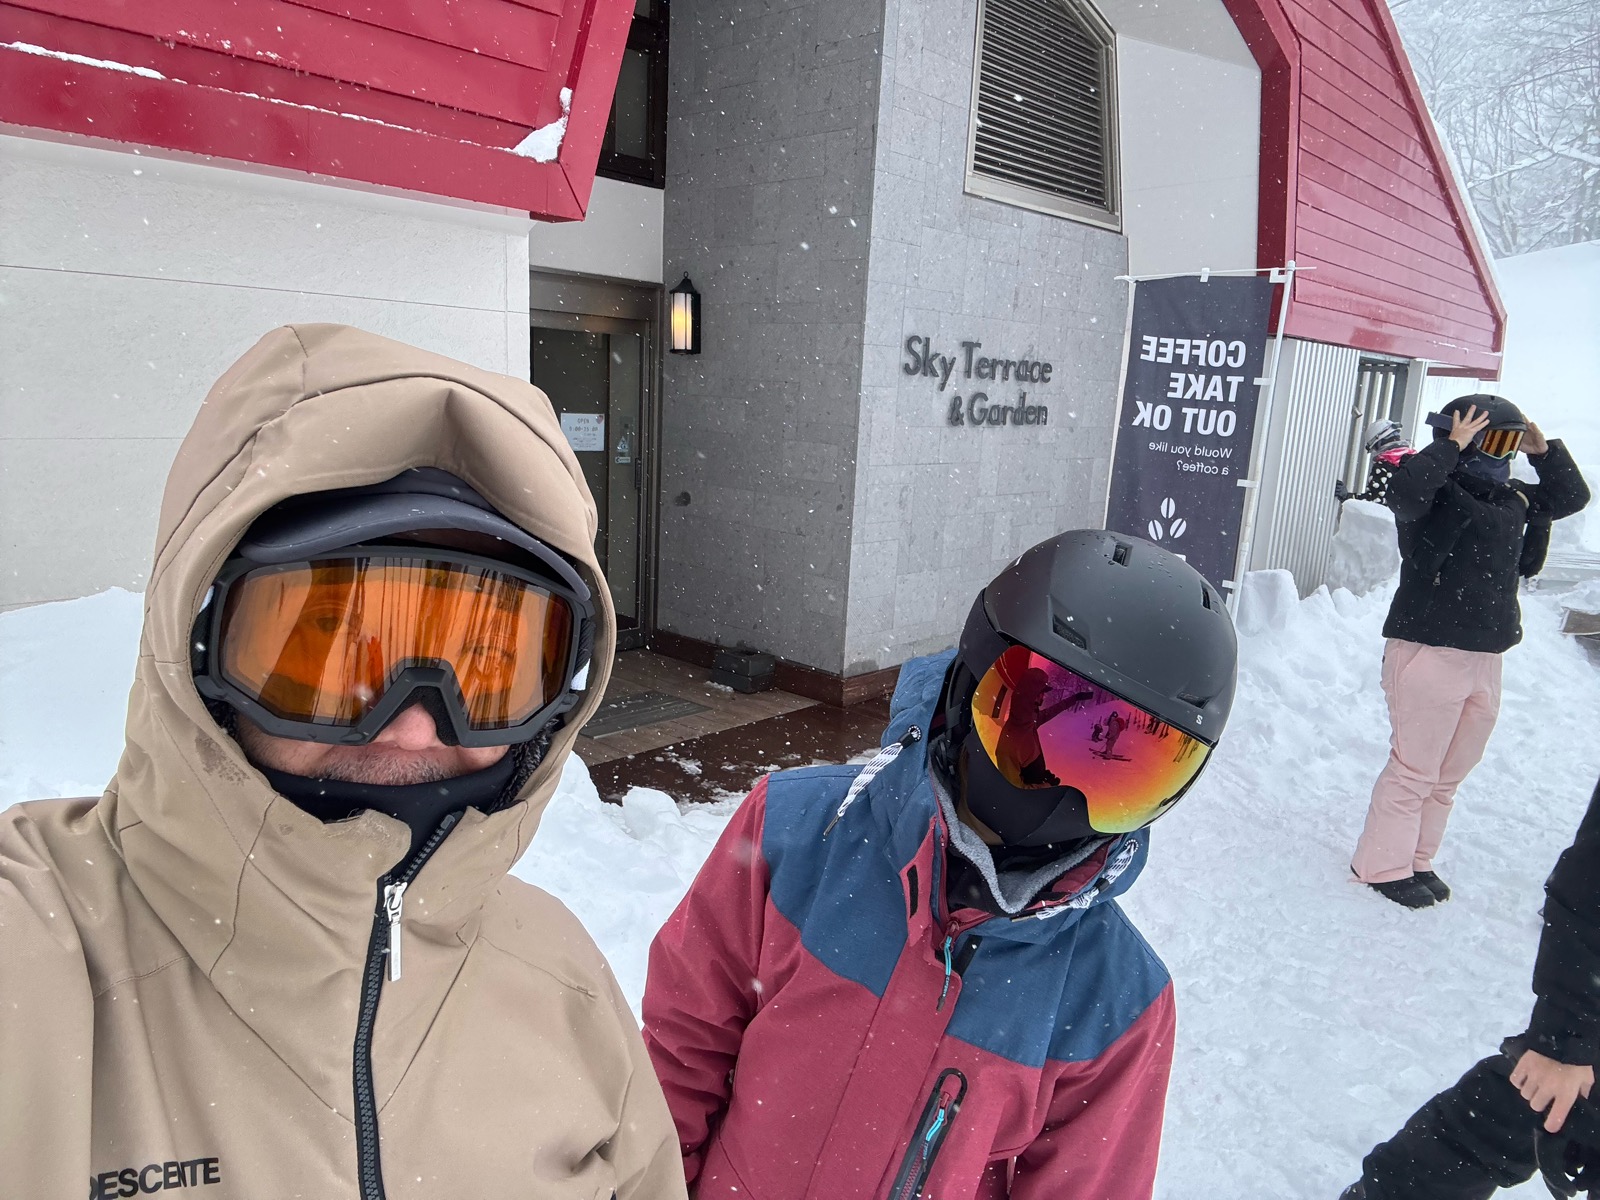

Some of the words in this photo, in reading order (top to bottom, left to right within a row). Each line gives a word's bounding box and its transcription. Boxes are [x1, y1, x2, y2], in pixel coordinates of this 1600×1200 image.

[903, 335, 956, 392] Sky
[961, 341, 1053, 384] Terrace
[949, 395, 965, 427] &
[968, 392, 1048, 426] Garden
